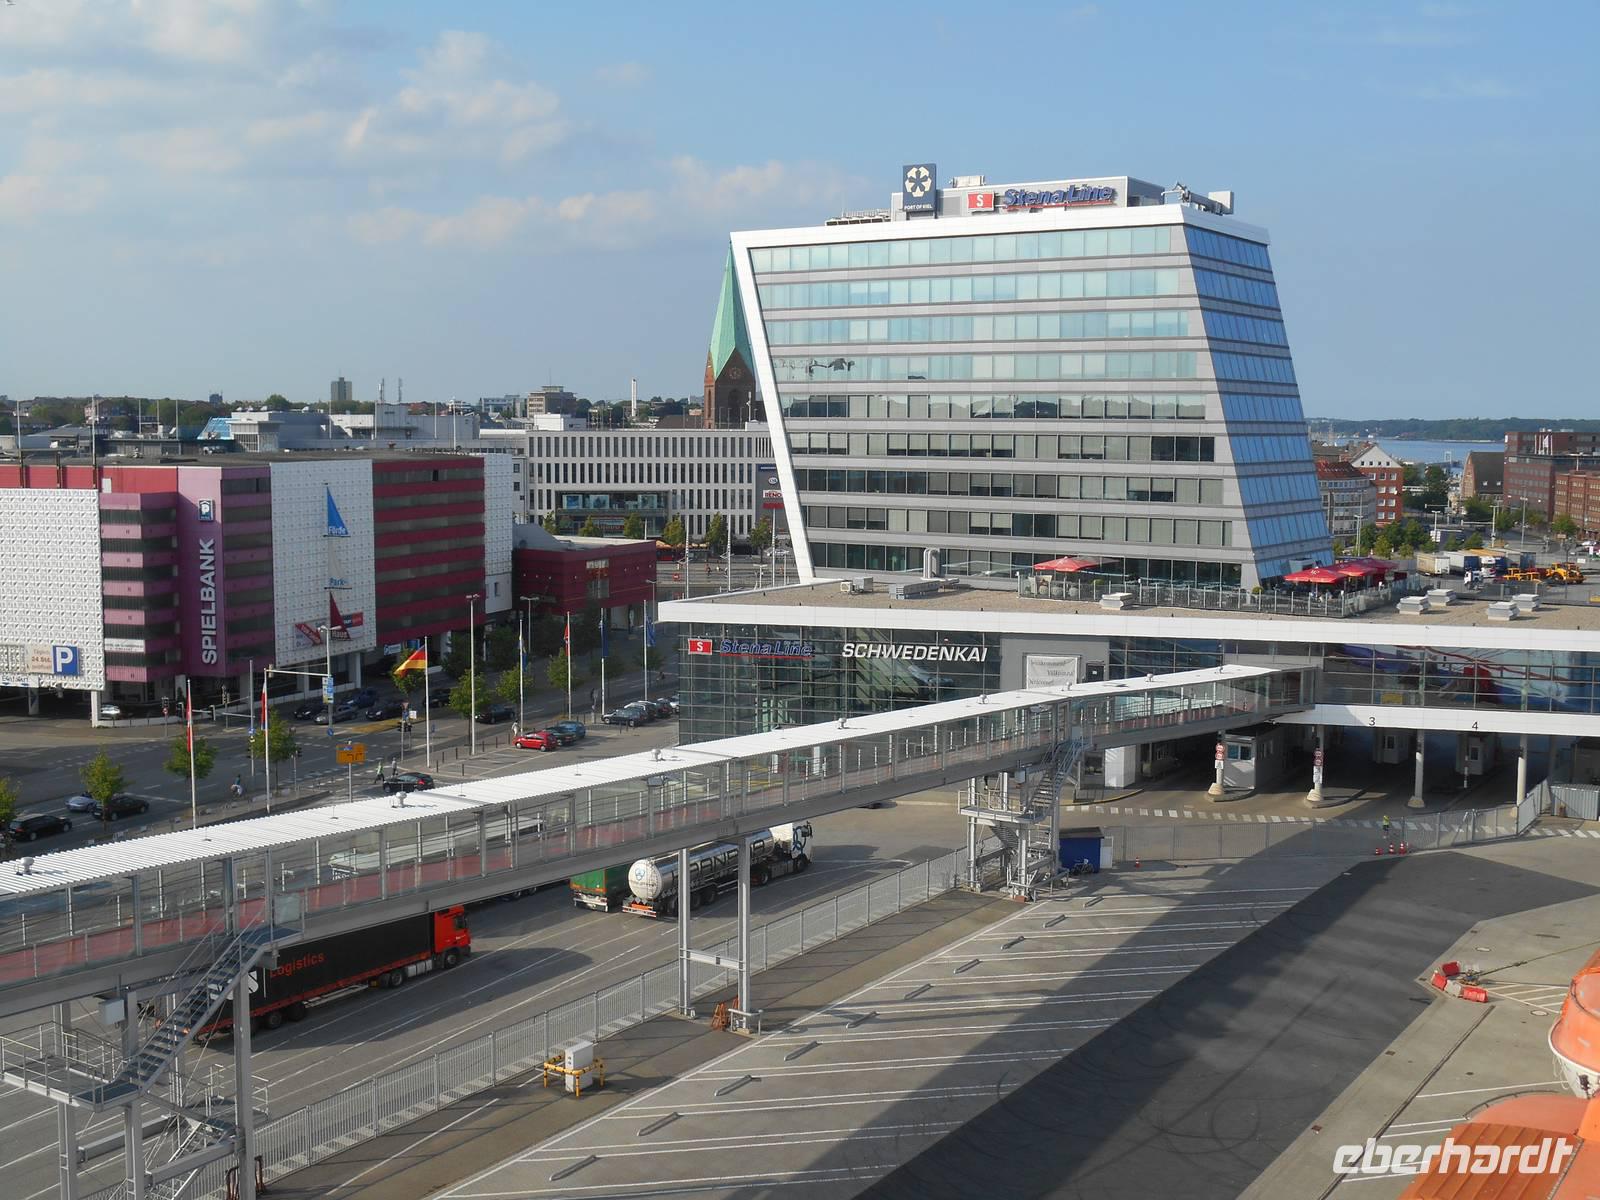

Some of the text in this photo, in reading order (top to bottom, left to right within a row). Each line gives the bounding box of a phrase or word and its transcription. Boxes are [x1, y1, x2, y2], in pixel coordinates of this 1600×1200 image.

[976, 184, 1113, 207] S Stena Line
[199, 538, 217, 665] SPIELBANK
[696, 639, 813, 656] S Stena Line
[841, 642, 988, 662] SCHWEDENKAI
[56, 647, 73, 672] P
[1368, 716, 1376, 727] 3
[1472, 721, 1479, 730] 4
